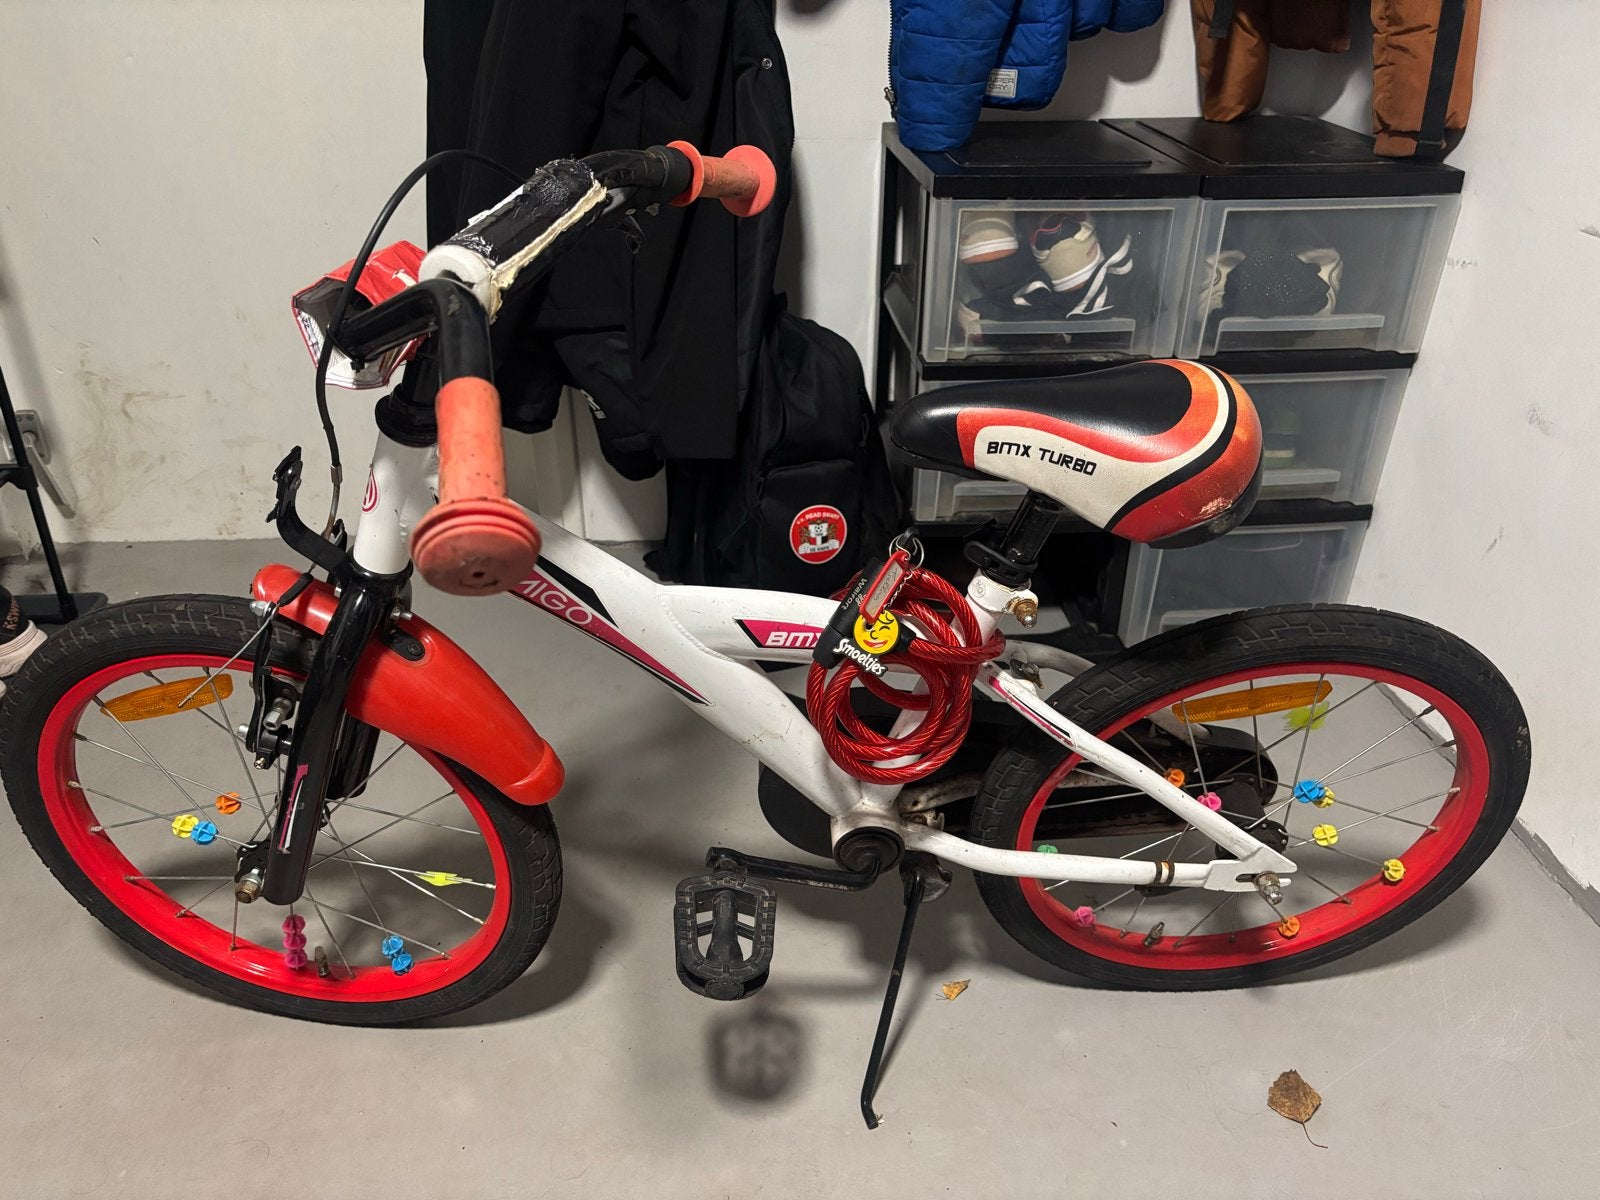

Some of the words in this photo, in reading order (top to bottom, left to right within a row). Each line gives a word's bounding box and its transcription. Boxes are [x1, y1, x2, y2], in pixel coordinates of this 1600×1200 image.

[987, 441, 1032, 458] BMX
[1038, 447, 1097, 476] TURBO
[833, 638, 886, 675] Smoeltjes
